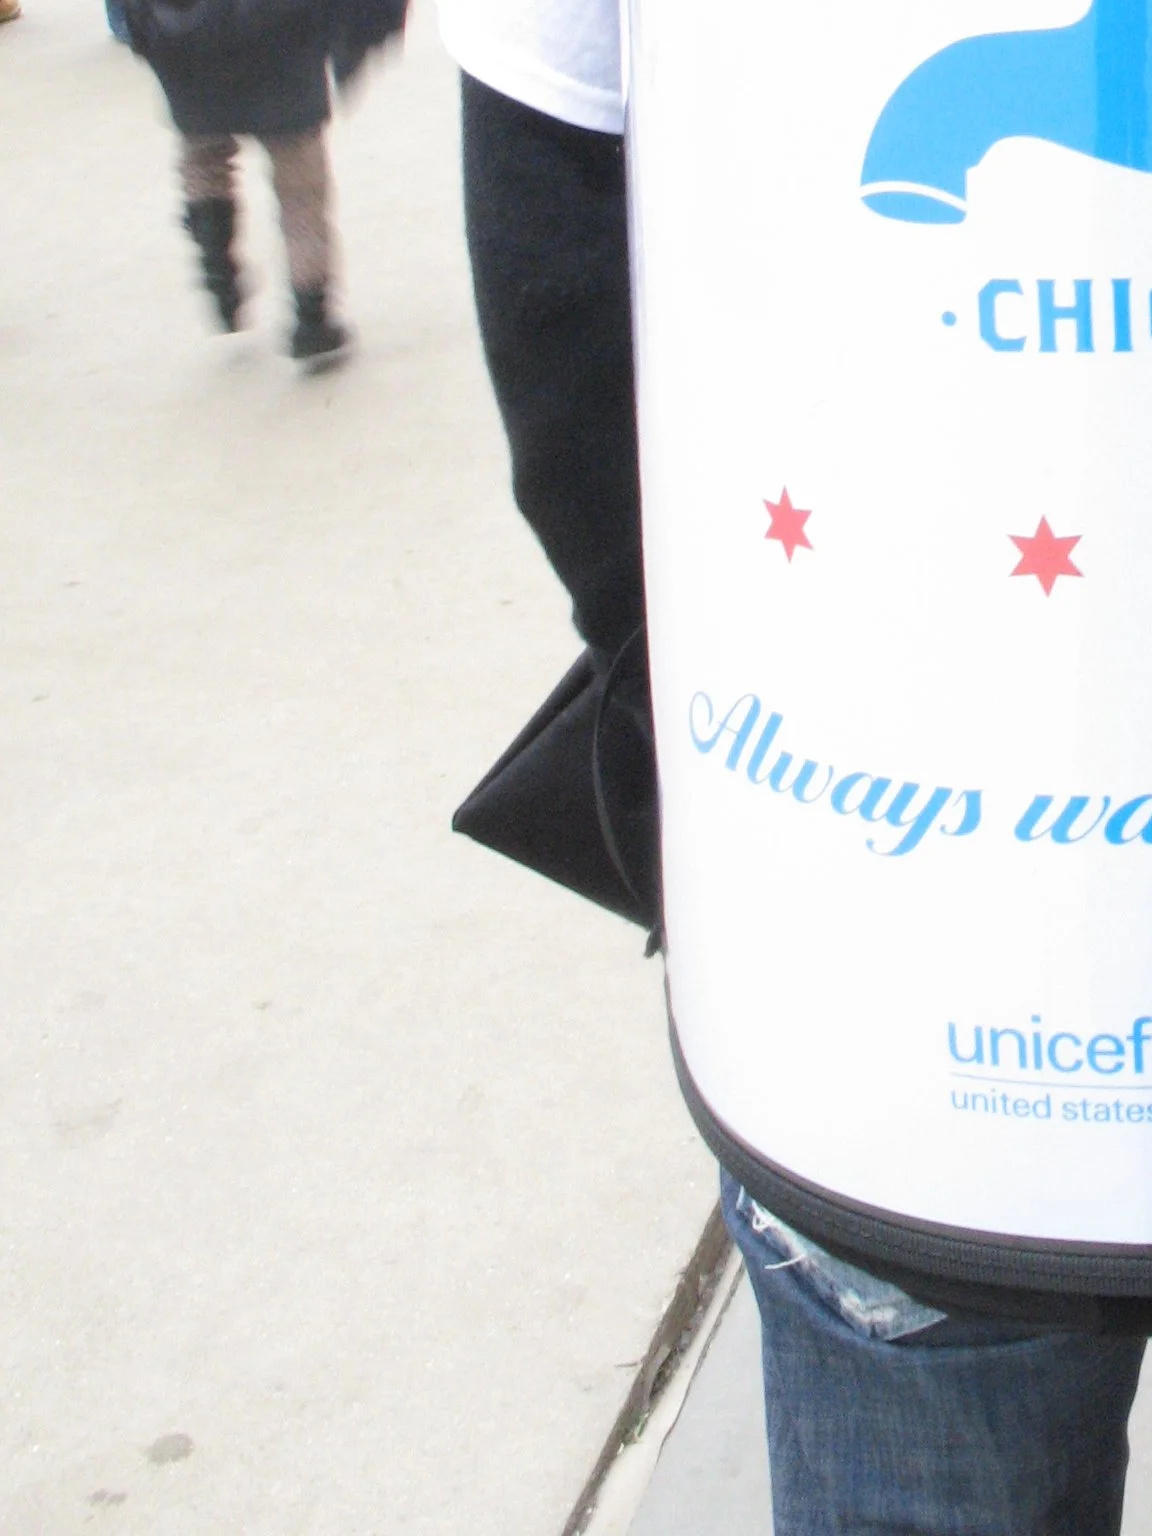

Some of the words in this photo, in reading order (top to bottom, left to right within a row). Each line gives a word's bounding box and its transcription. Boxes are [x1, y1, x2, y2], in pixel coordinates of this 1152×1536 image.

[688, 691, 984, 857] Always
[946, 1013, 1152, 1076] unicef
[949, 1087, 1052, 1121] united
